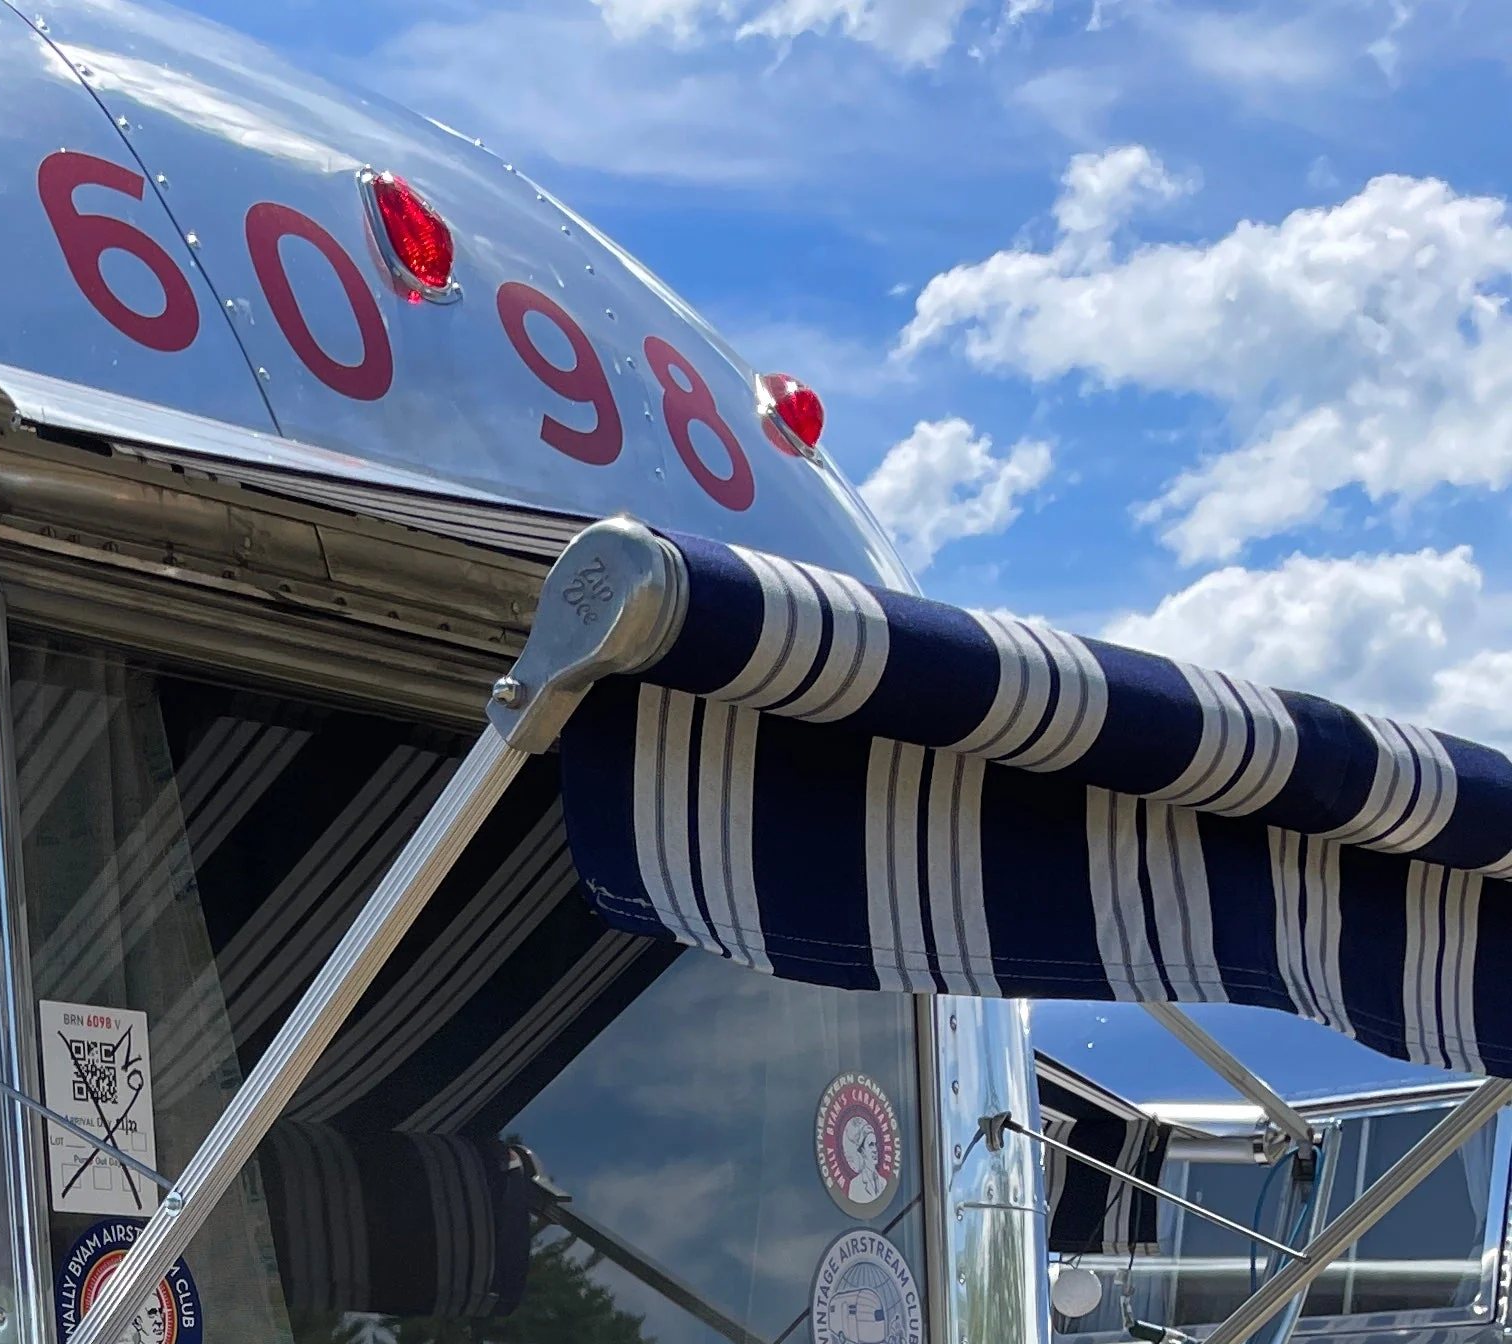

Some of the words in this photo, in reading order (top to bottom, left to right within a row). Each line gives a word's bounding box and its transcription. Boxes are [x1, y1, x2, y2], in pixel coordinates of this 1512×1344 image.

[37, 150, 756, 513] 6098
[562, 579, 598, 626] Dee
[577, 556, 614, 602] Zip
[63, 1013, 84, 1026] BRN
[86, 1014, 112, 1030] 6098
[114, 1020, 121, 1030] V
[816, 1074, 854, 1188] SOUTHEASTERN
[857, 1075, 897, 1130] CAMPING
[893, 1137, 901, 1179] UNIT
[826, 1147, 846, 1189] WALLY
[68, 1233, 102, 1277] BYAM
[176, 1279, 195, 1328] CLUB
[839, 1236, 910, 1288] AIRSTREAM
